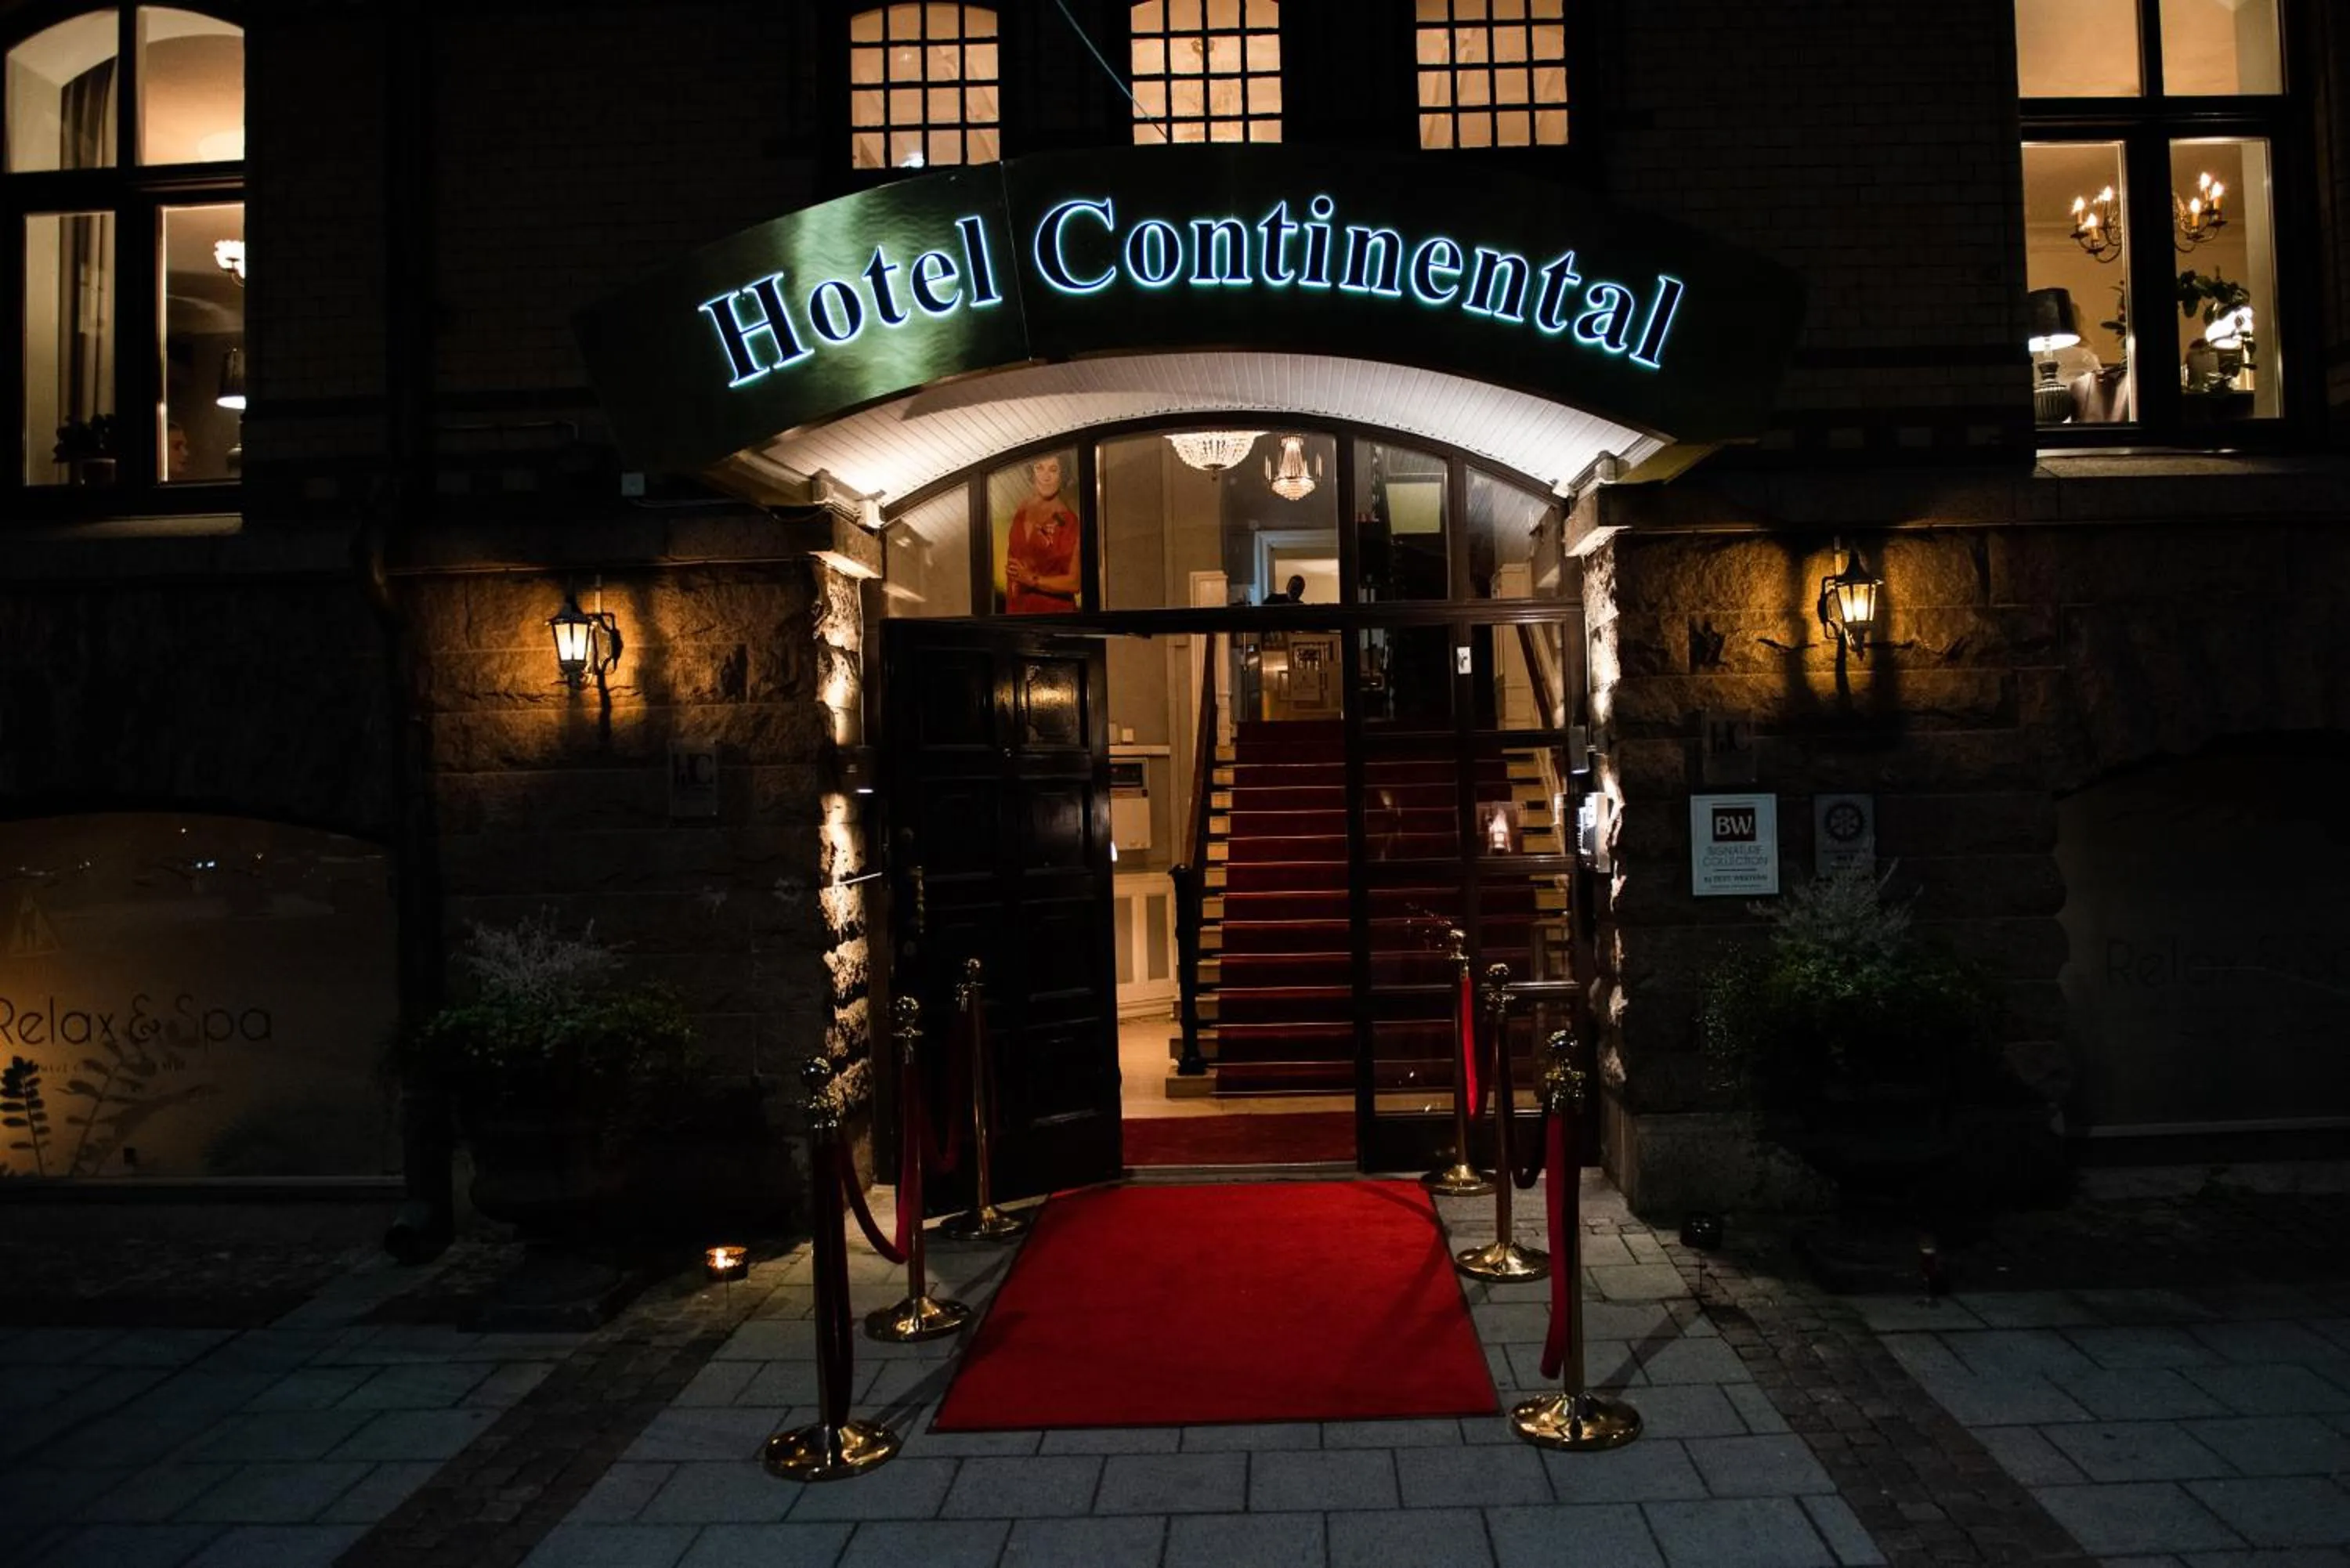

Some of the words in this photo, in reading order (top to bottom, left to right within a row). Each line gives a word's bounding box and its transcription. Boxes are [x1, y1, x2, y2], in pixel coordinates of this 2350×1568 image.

[697, 215, 1003, 388] Hotel
[1034, 195, 1684, 370] Continental
[128, 993, 161, 1043] &
